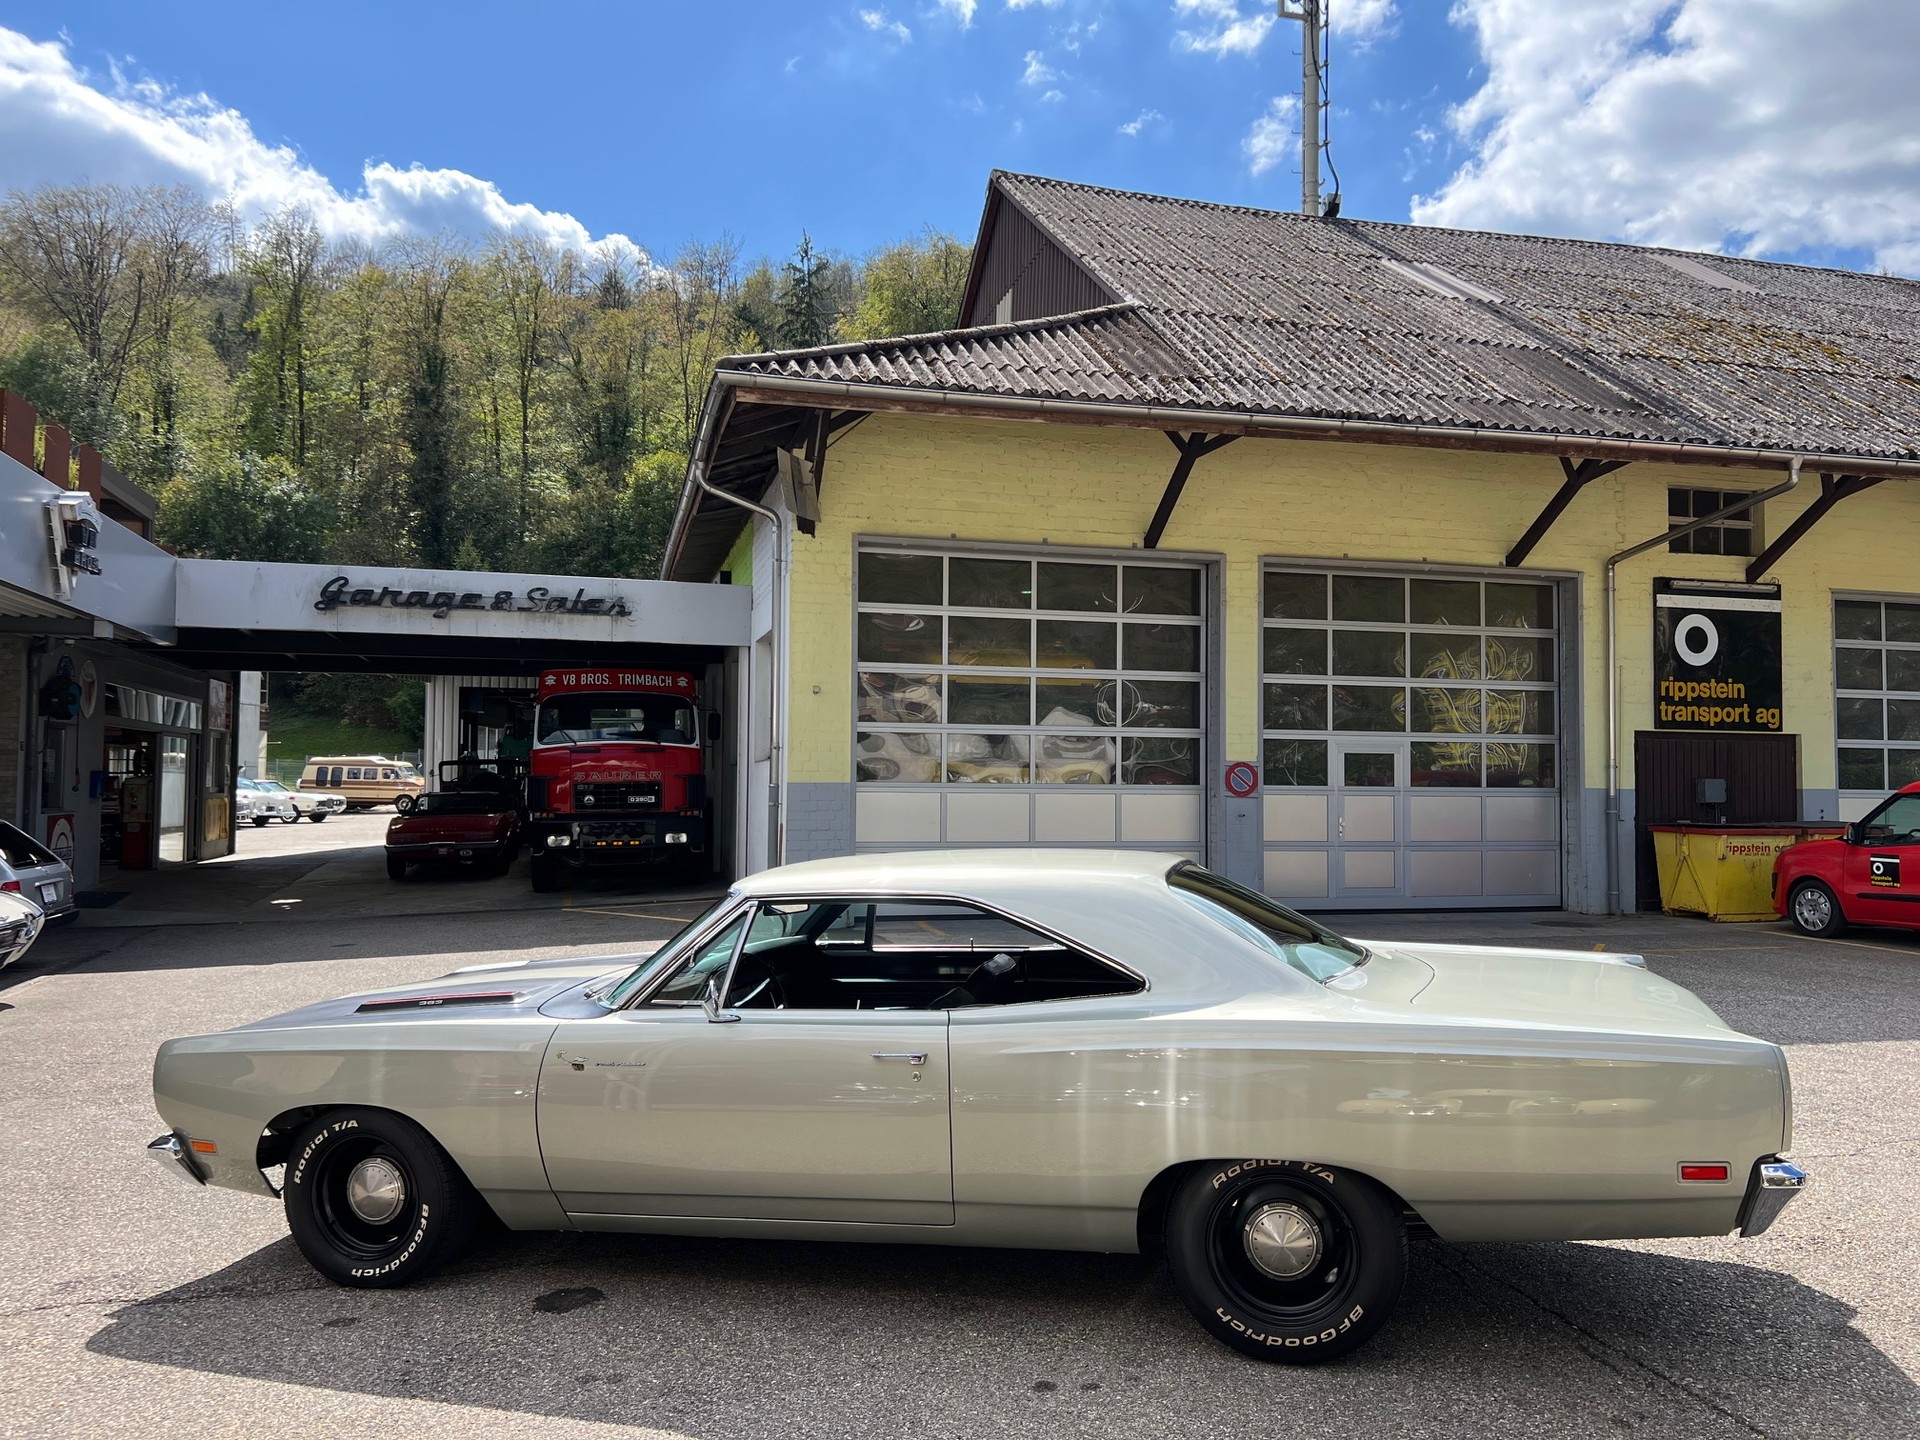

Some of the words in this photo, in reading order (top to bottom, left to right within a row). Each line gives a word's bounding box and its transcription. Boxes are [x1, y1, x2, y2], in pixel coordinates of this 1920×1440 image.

[313, 576, 486, 618] Garage
[490, 590, 513, 612] &
[517, 587, 632, 616] Sales
[562, 674, 577, 686] V8
[580, 673, 613, 686] BROS.
[618, 673, 672, 687] TRIMBACH
[1660, 676, 1745, 701] rippstein
[1660, 701, 1750, 726] transport
[1755, 707, 1780, 729] ag
[573, 771, 662, 780] SAURER
[293, 1129, 329, 1184] Radial
[332, 1119, 359, 1132] T/A
[1302, 1161, 1336, 1185] T/A
[351, 1203, 430, 1278] BFGoodrich
[1216, 1304, 1364, 1347] BFGoodrich
